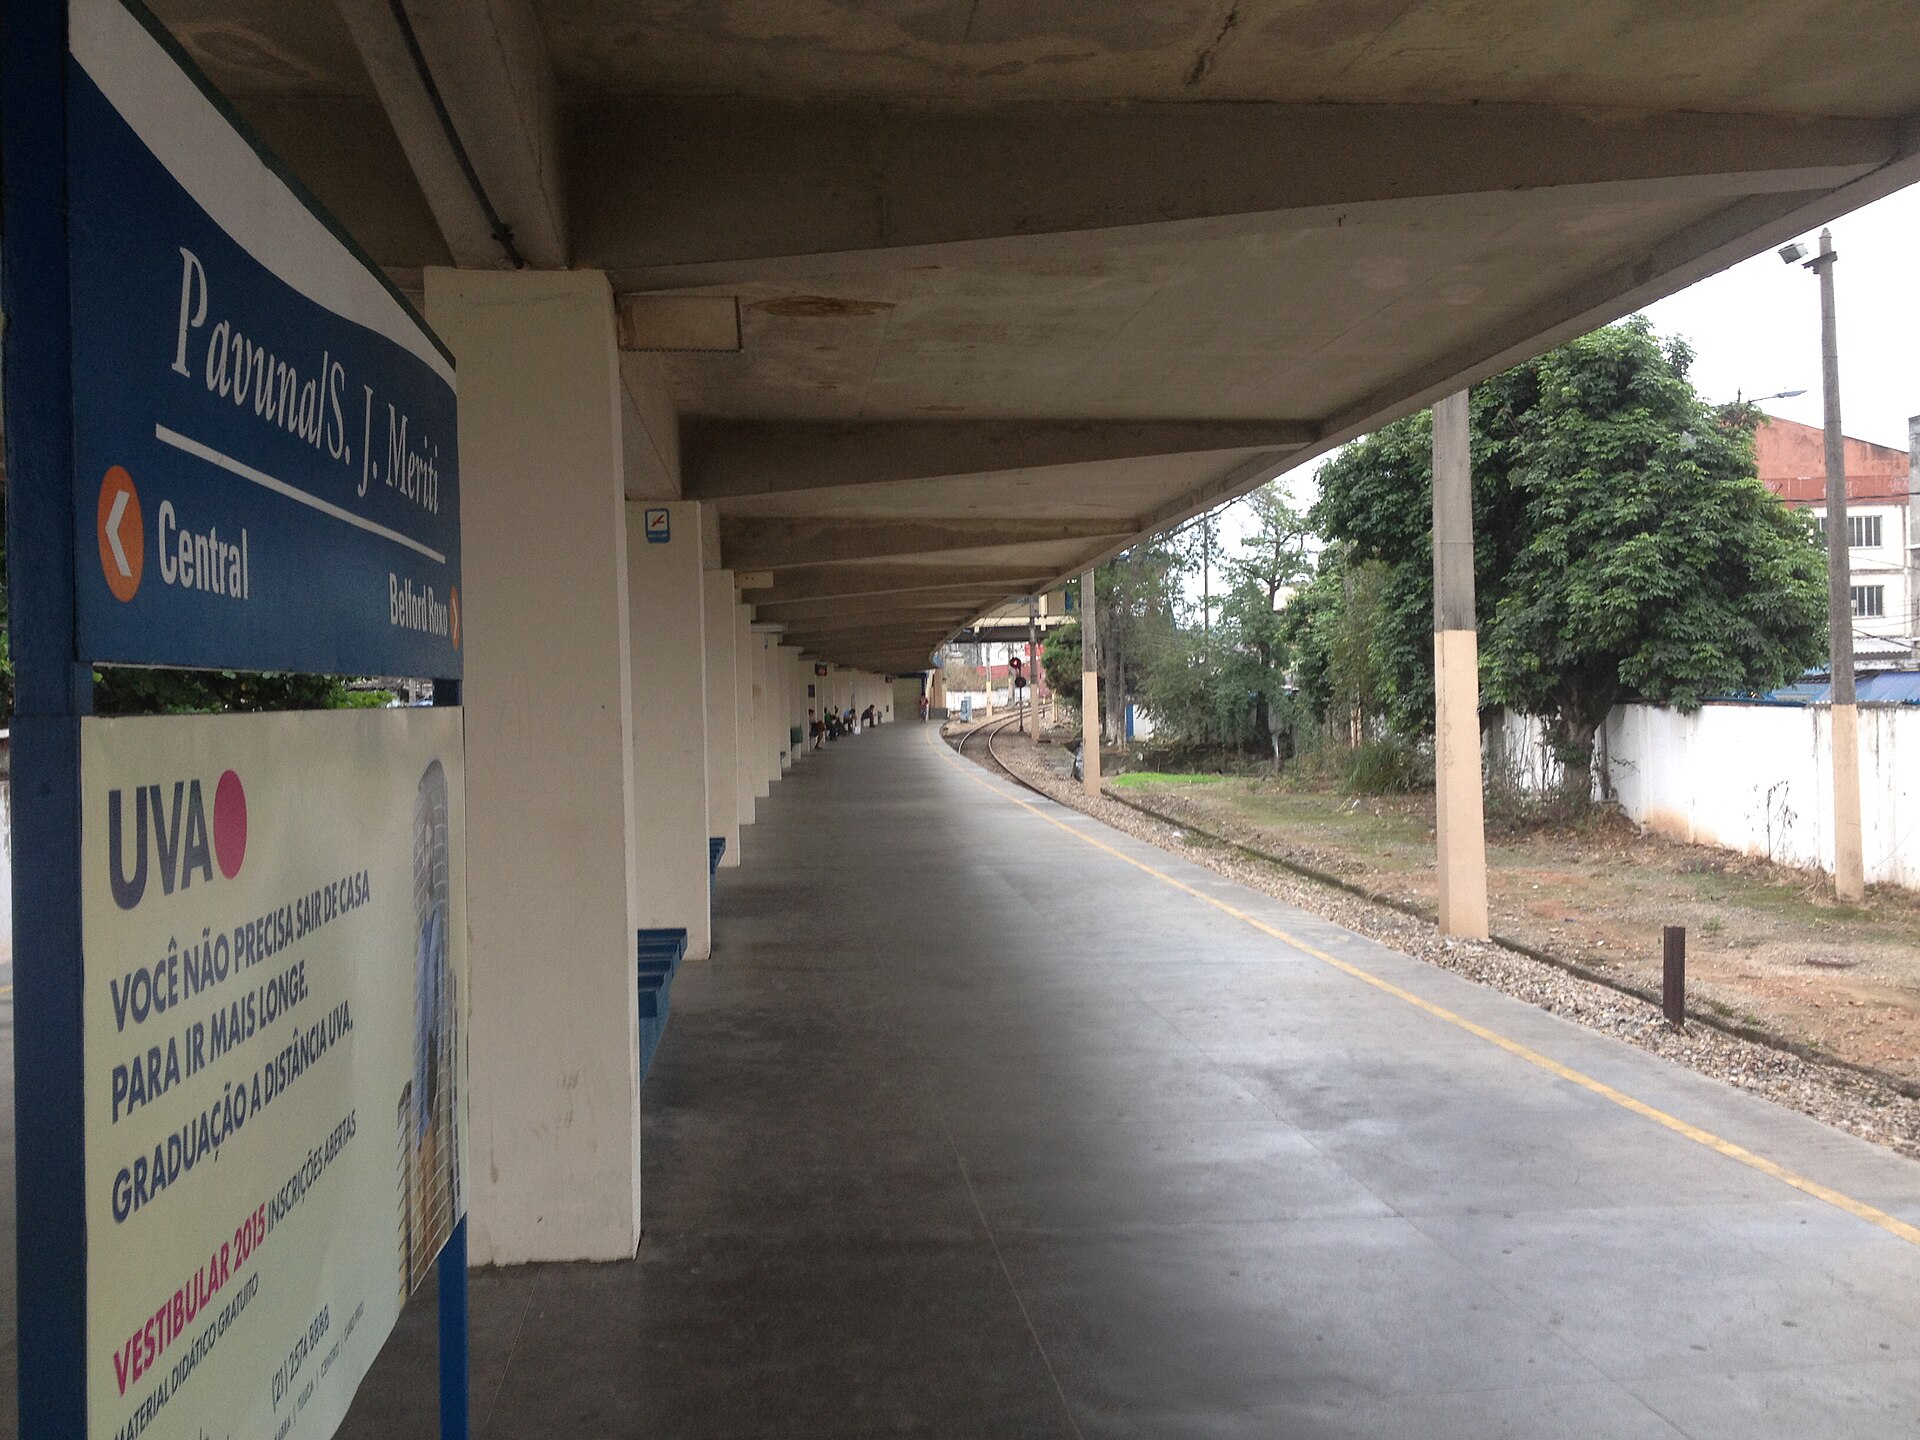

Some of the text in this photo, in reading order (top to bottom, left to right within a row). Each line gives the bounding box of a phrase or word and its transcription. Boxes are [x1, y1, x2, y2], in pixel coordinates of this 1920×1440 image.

[171, 247, 439, 515] Pavuna/S. J. Meriti
[158, 499, 249, 600] Central
[389, 572, 448, 636] Belford Roxo
[108, 778, 213, 910] UVA
[109, 869, 370, 1033] VOCÊ NÃO PRECISA SAIR DE CASA
[112, 959, 309, 1126] PARA IR MAIS LONGE.
[112, 1000, 354, 1224] GRADUAÇÃO A DISTÂNCIA UVA.
[113, 1242, 230, 1397] VESTIBULAR
[233, 1202, 266, 1275] 2015
[267, 1143, 324, 1235] INSCRIÇÕES
[323, 1108, 357, 1172] ABERTAS
[171, 1321, 217, 1396] DIDÁTICO
[218, 1271, 259, 1339] GRATUITO
